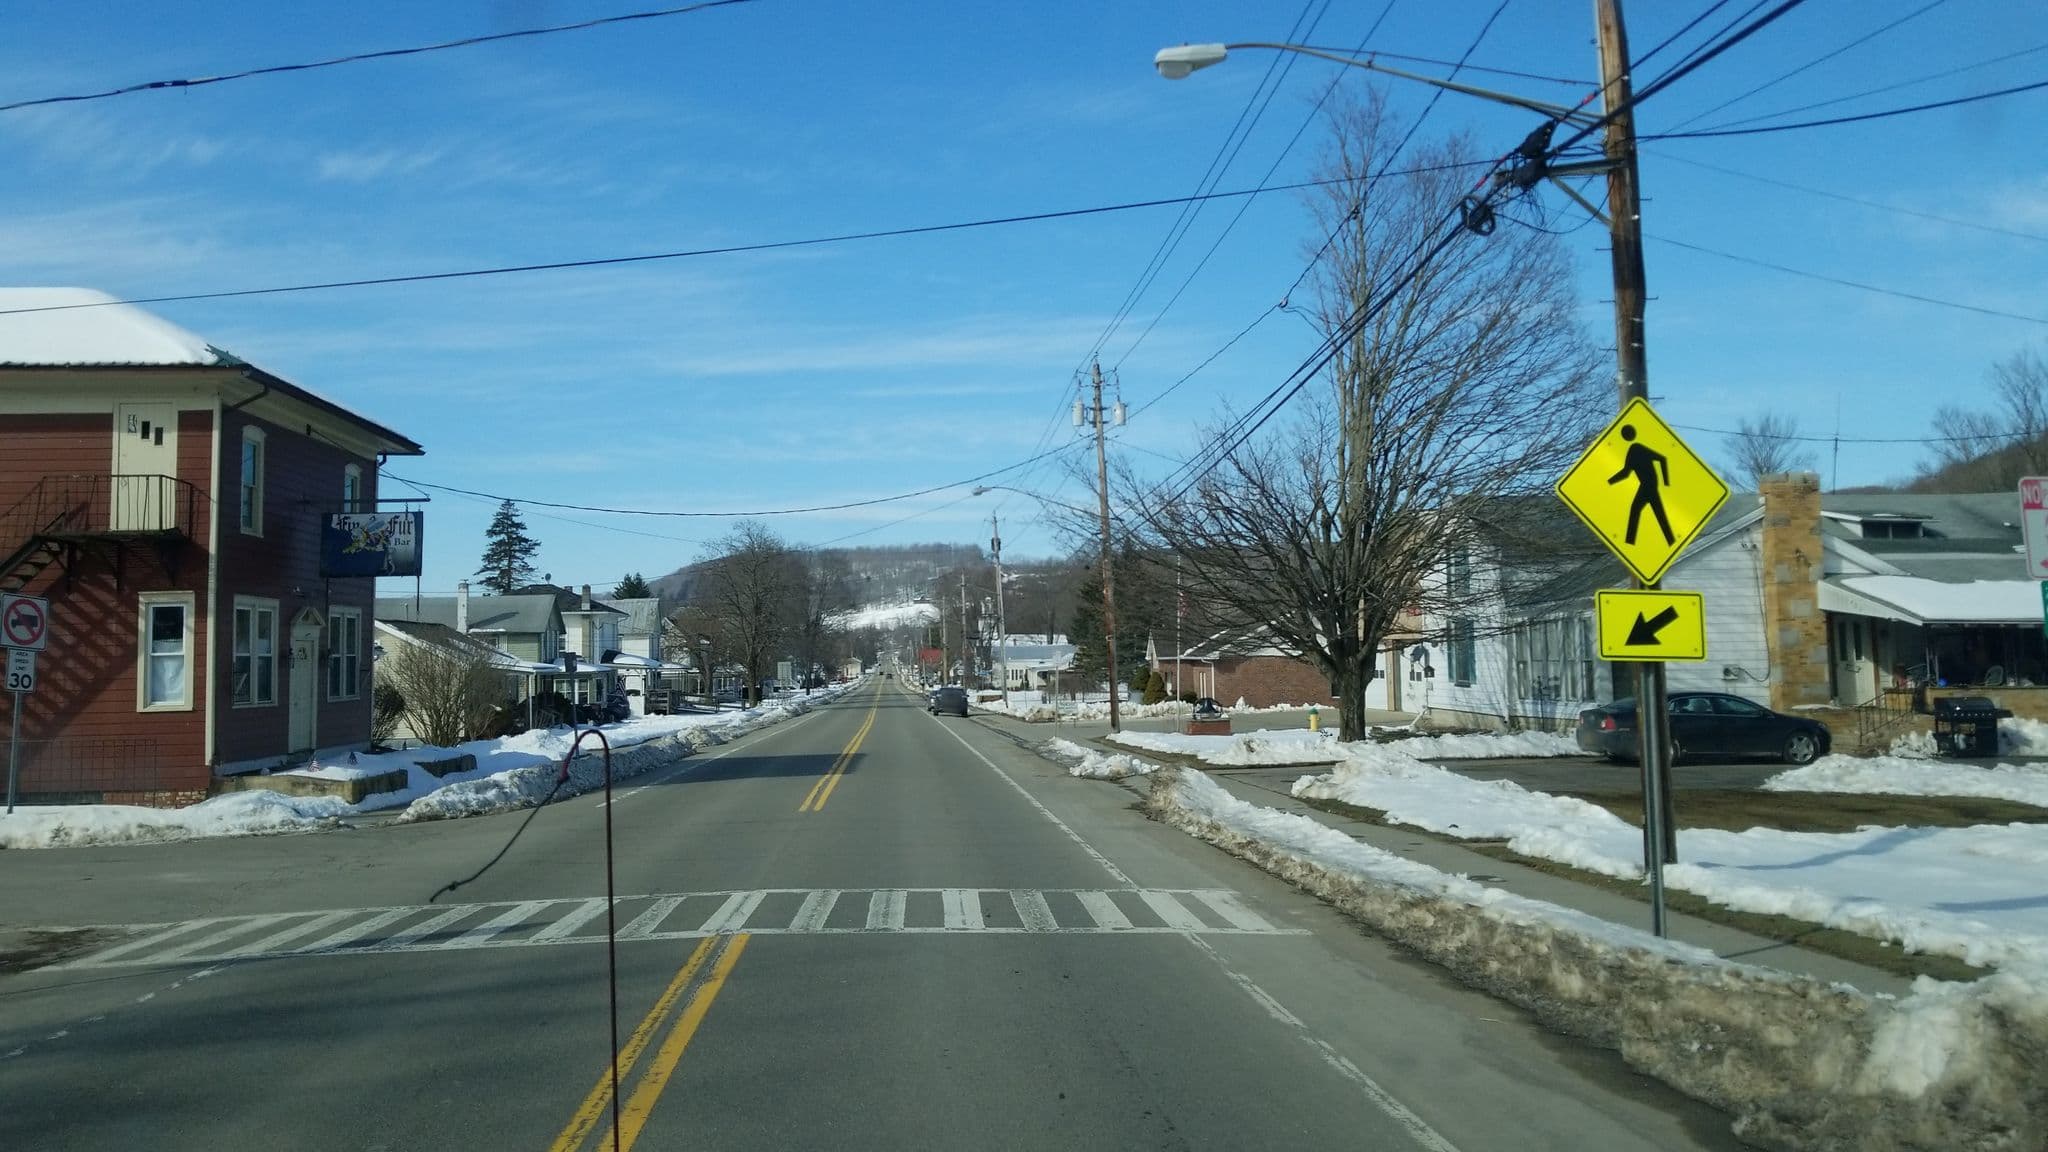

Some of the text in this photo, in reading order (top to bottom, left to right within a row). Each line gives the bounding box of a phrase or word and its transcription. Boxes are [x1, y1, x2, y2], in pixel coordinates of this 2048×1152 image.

[2023, 486, 2041, 504] NO
[387, 515, 413, 537] Fur
[9, 673, 32, 689] 30
